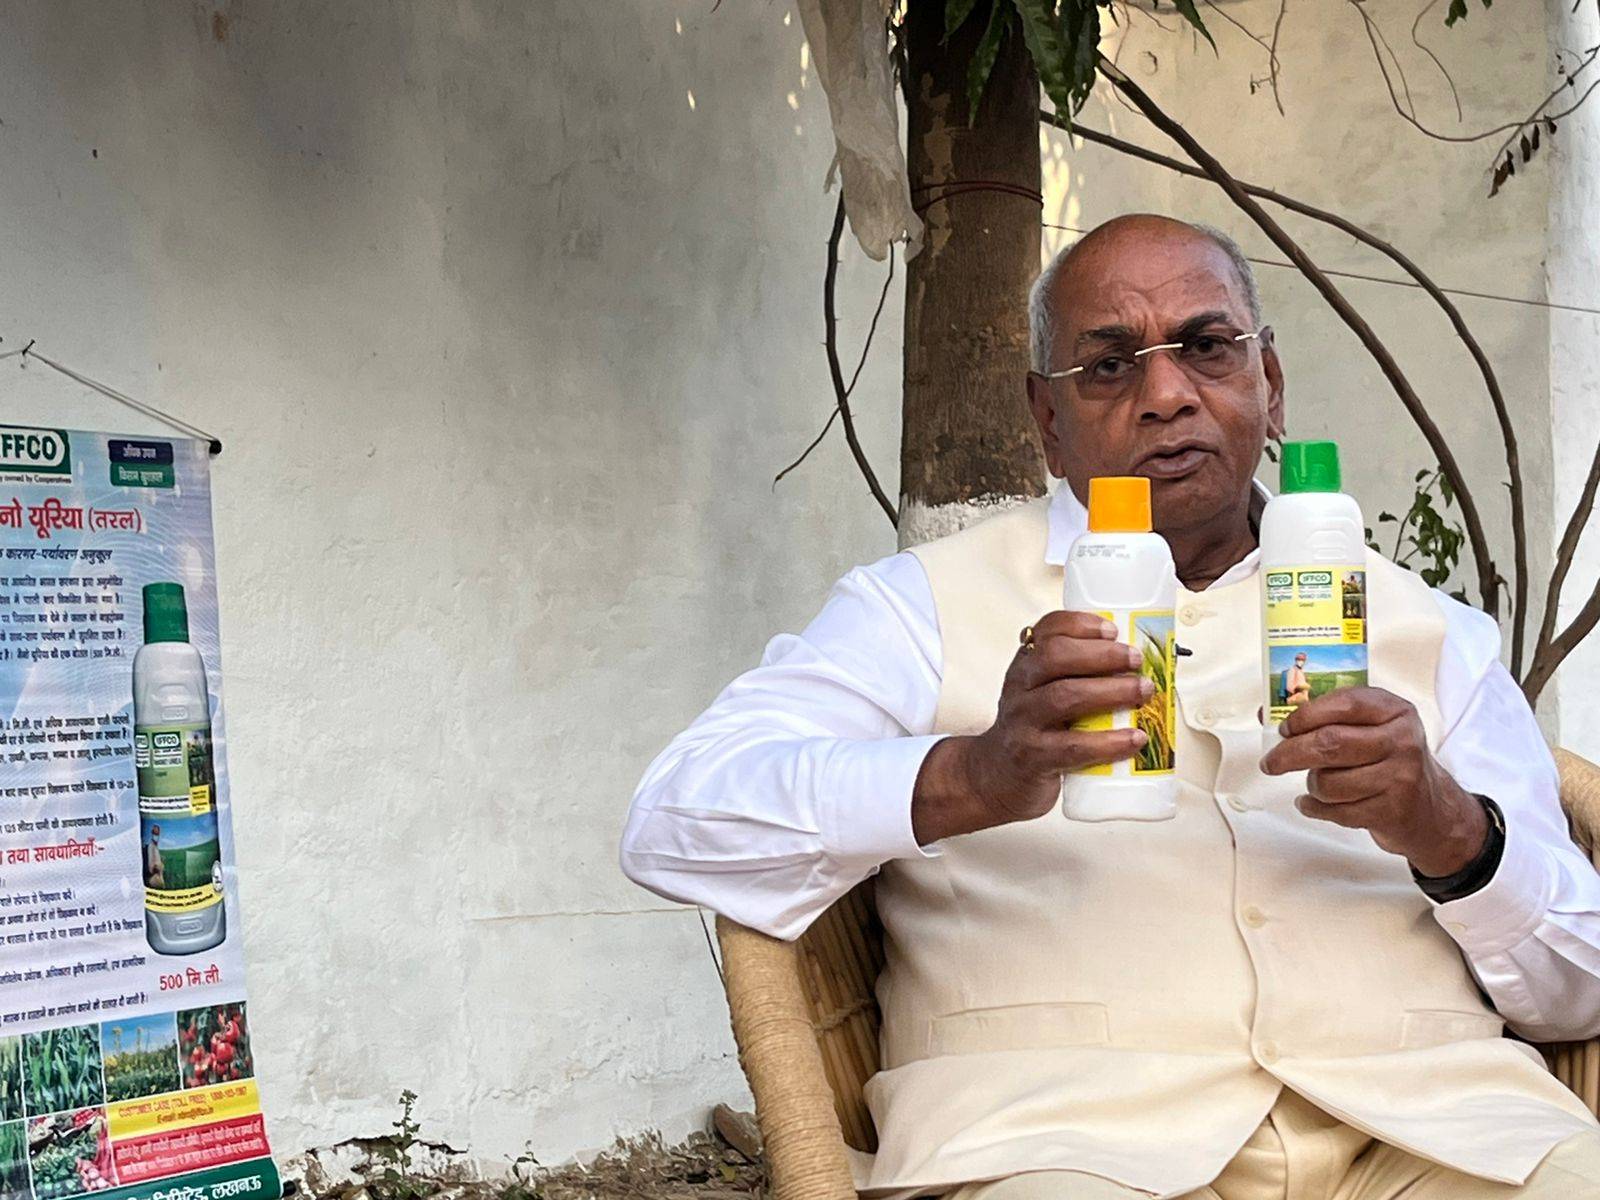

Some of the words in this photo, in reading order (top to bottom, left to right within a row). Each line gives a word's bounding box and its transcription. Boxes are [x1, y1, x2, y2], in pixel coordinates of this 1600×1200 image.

[0, 433, 57, 460] FFCO
[0, 497, 22, 528] नो
[28, 498, 83, 539] यूरिया
[89, 507, 141, 533] (तरल)
[80, 549, 113, 565] अनुकूल
[160, 973, 183, 990] 500
[210, 1175, 262, 1199] लखनऊ
